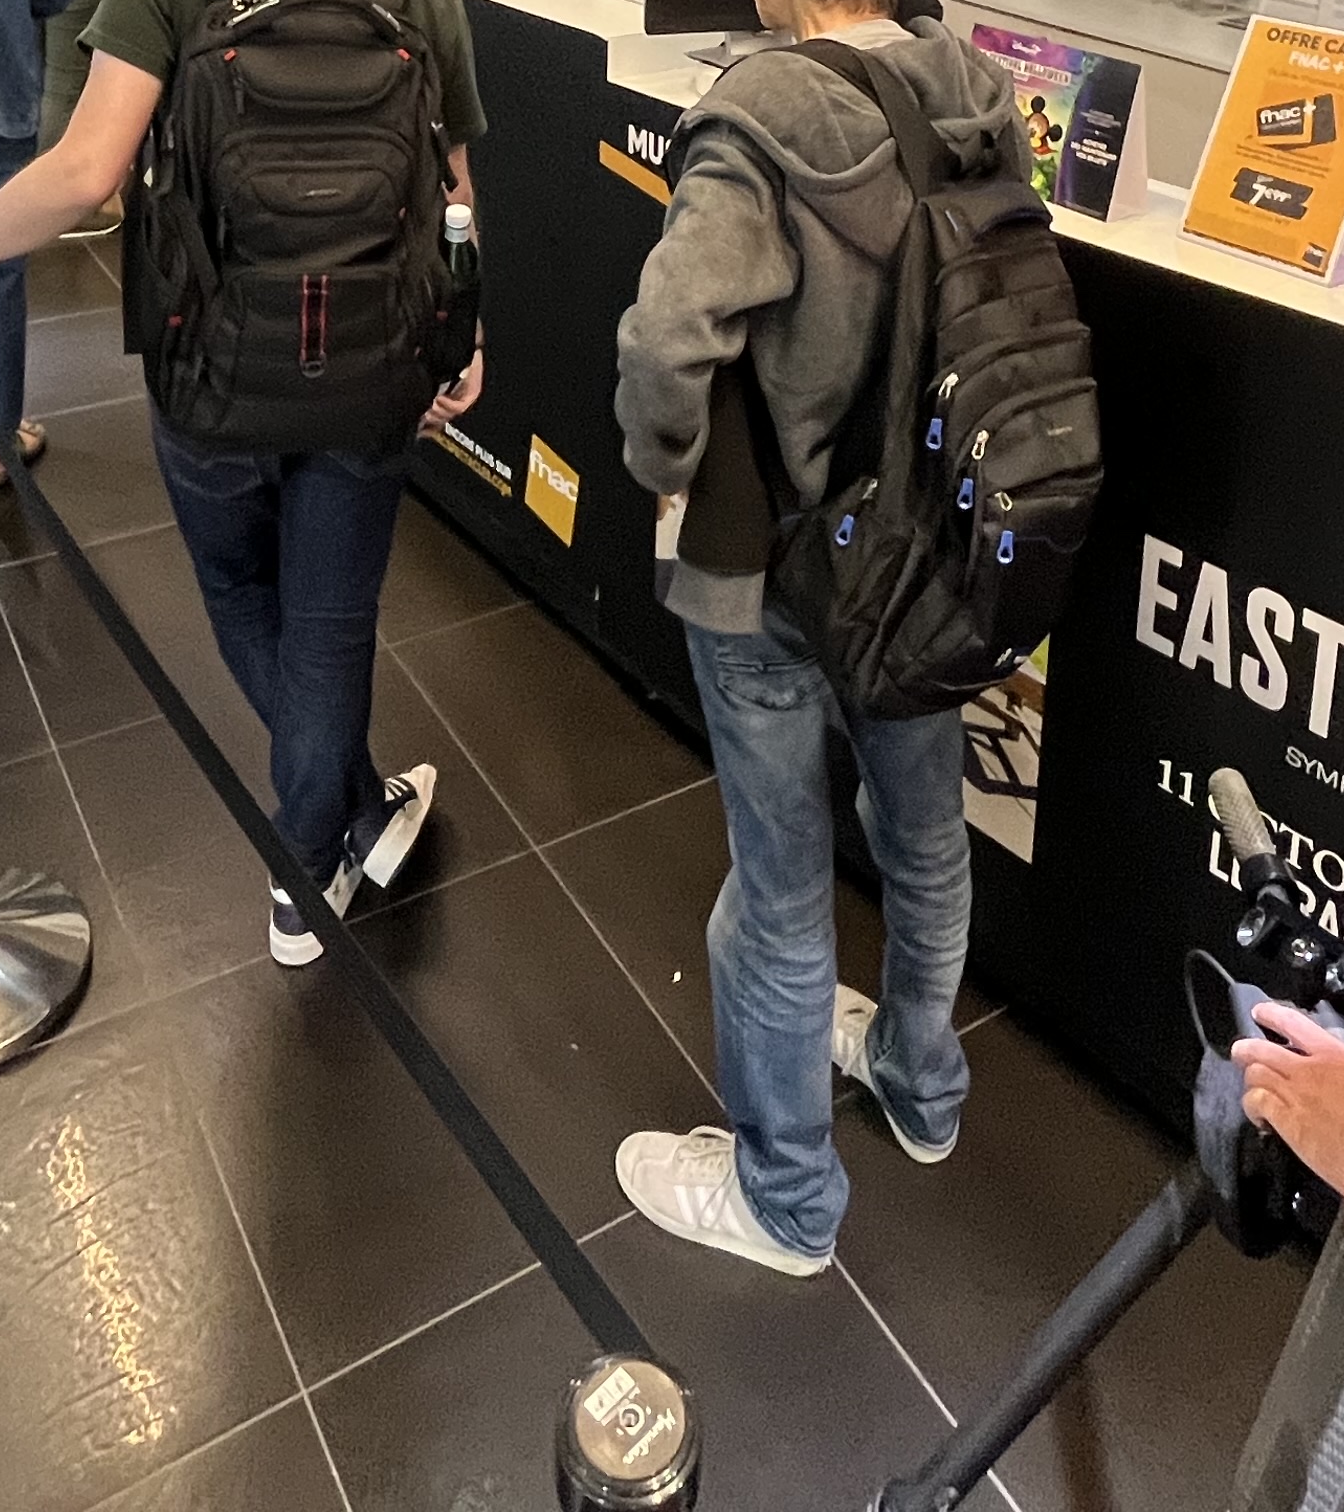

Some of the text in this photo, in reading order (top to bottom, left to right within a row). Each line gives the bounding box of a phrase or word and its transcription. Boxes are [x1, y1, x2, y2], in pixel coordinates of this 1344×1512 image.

[1266, 27, 1322, 51] OFFRE
[1288, 51, 1331, 71] FNAC
[1259, 105, 1301, 124] fnac
[628, 124, 672, 166] MU
[529, 449, 578, 502] fnac
[1158, 759, 1195, 807] 11
